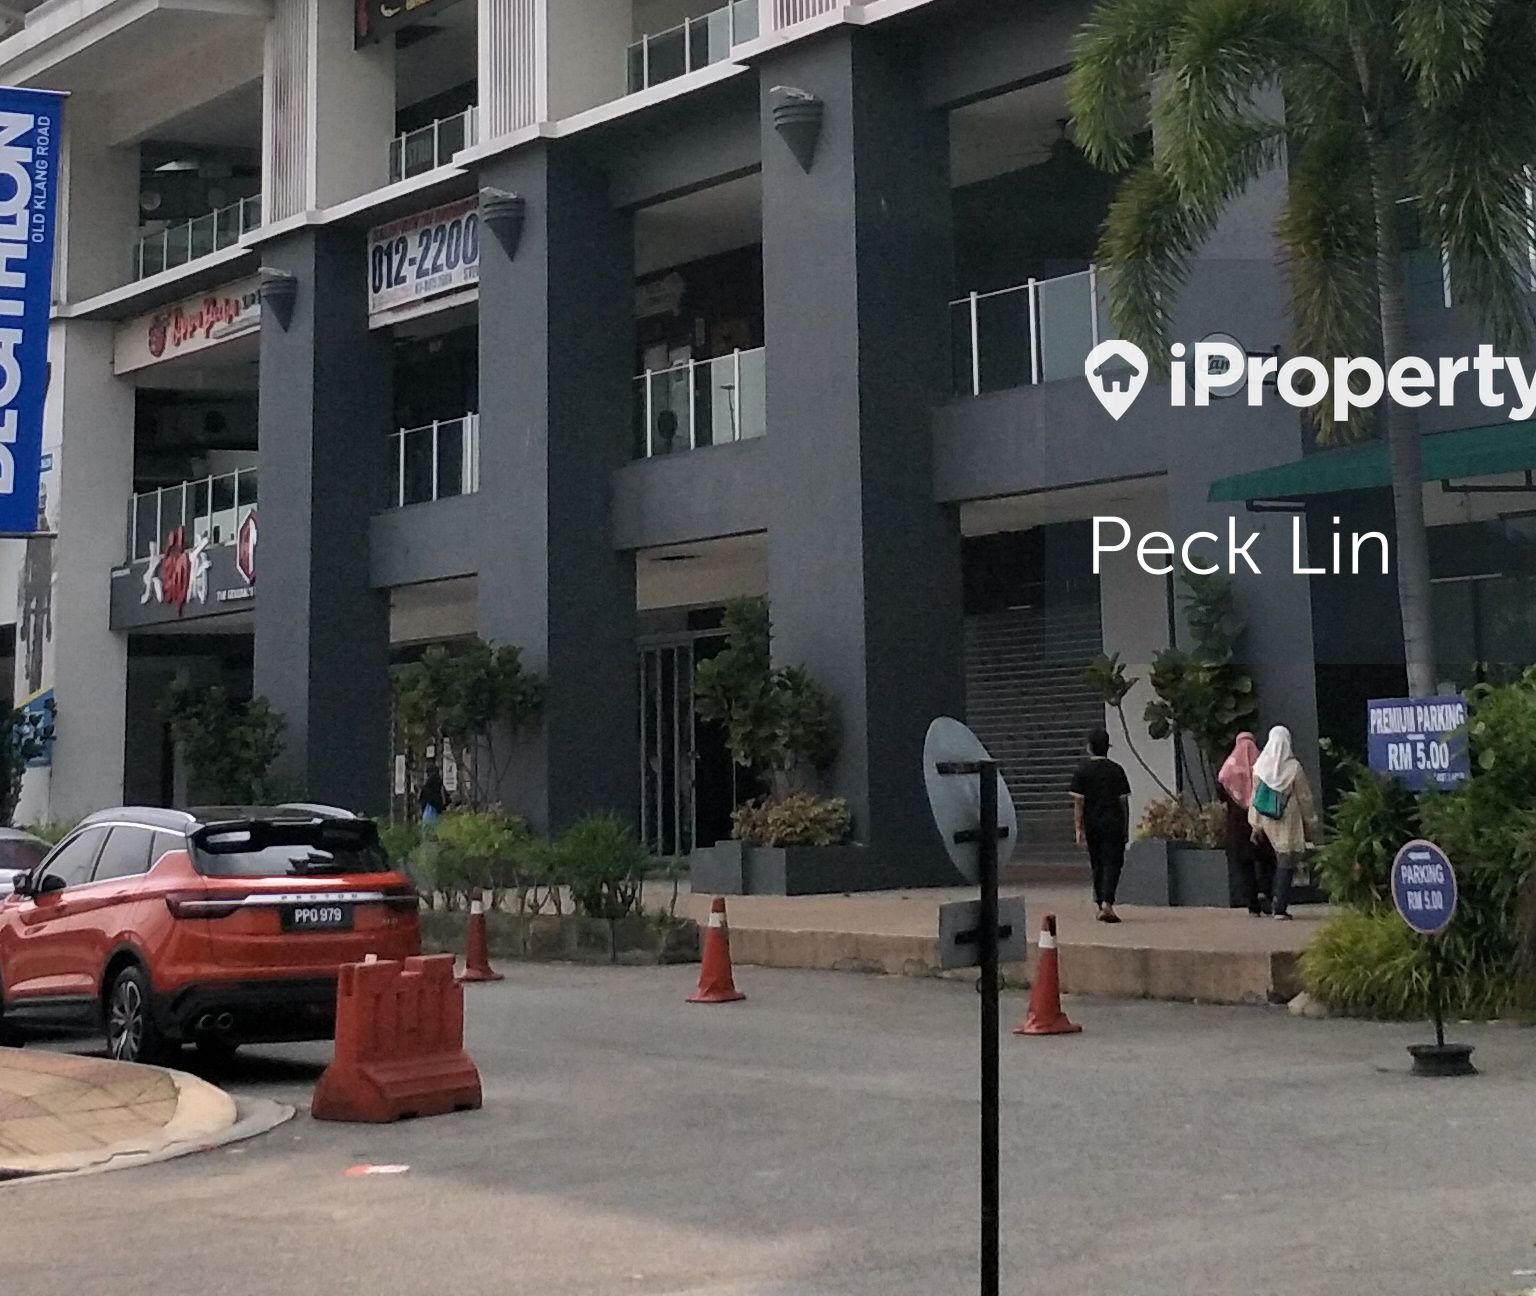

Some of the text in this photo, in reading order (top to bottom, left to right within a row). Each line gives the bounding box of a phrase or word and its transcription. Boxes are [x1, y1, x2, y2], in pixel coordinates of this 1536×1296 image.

[31, 115, 51, 244] OLD KLANG ROAD
[1370, 703, 1464, 735] PREMIUM PARKING
[1387, 740, 1450, 771] RM 5.00
[1400, 863, 1445, 886] PARKING
[1407, 889, 1444, 911] RM 5.00
[319, 906, 342, 922] 979
